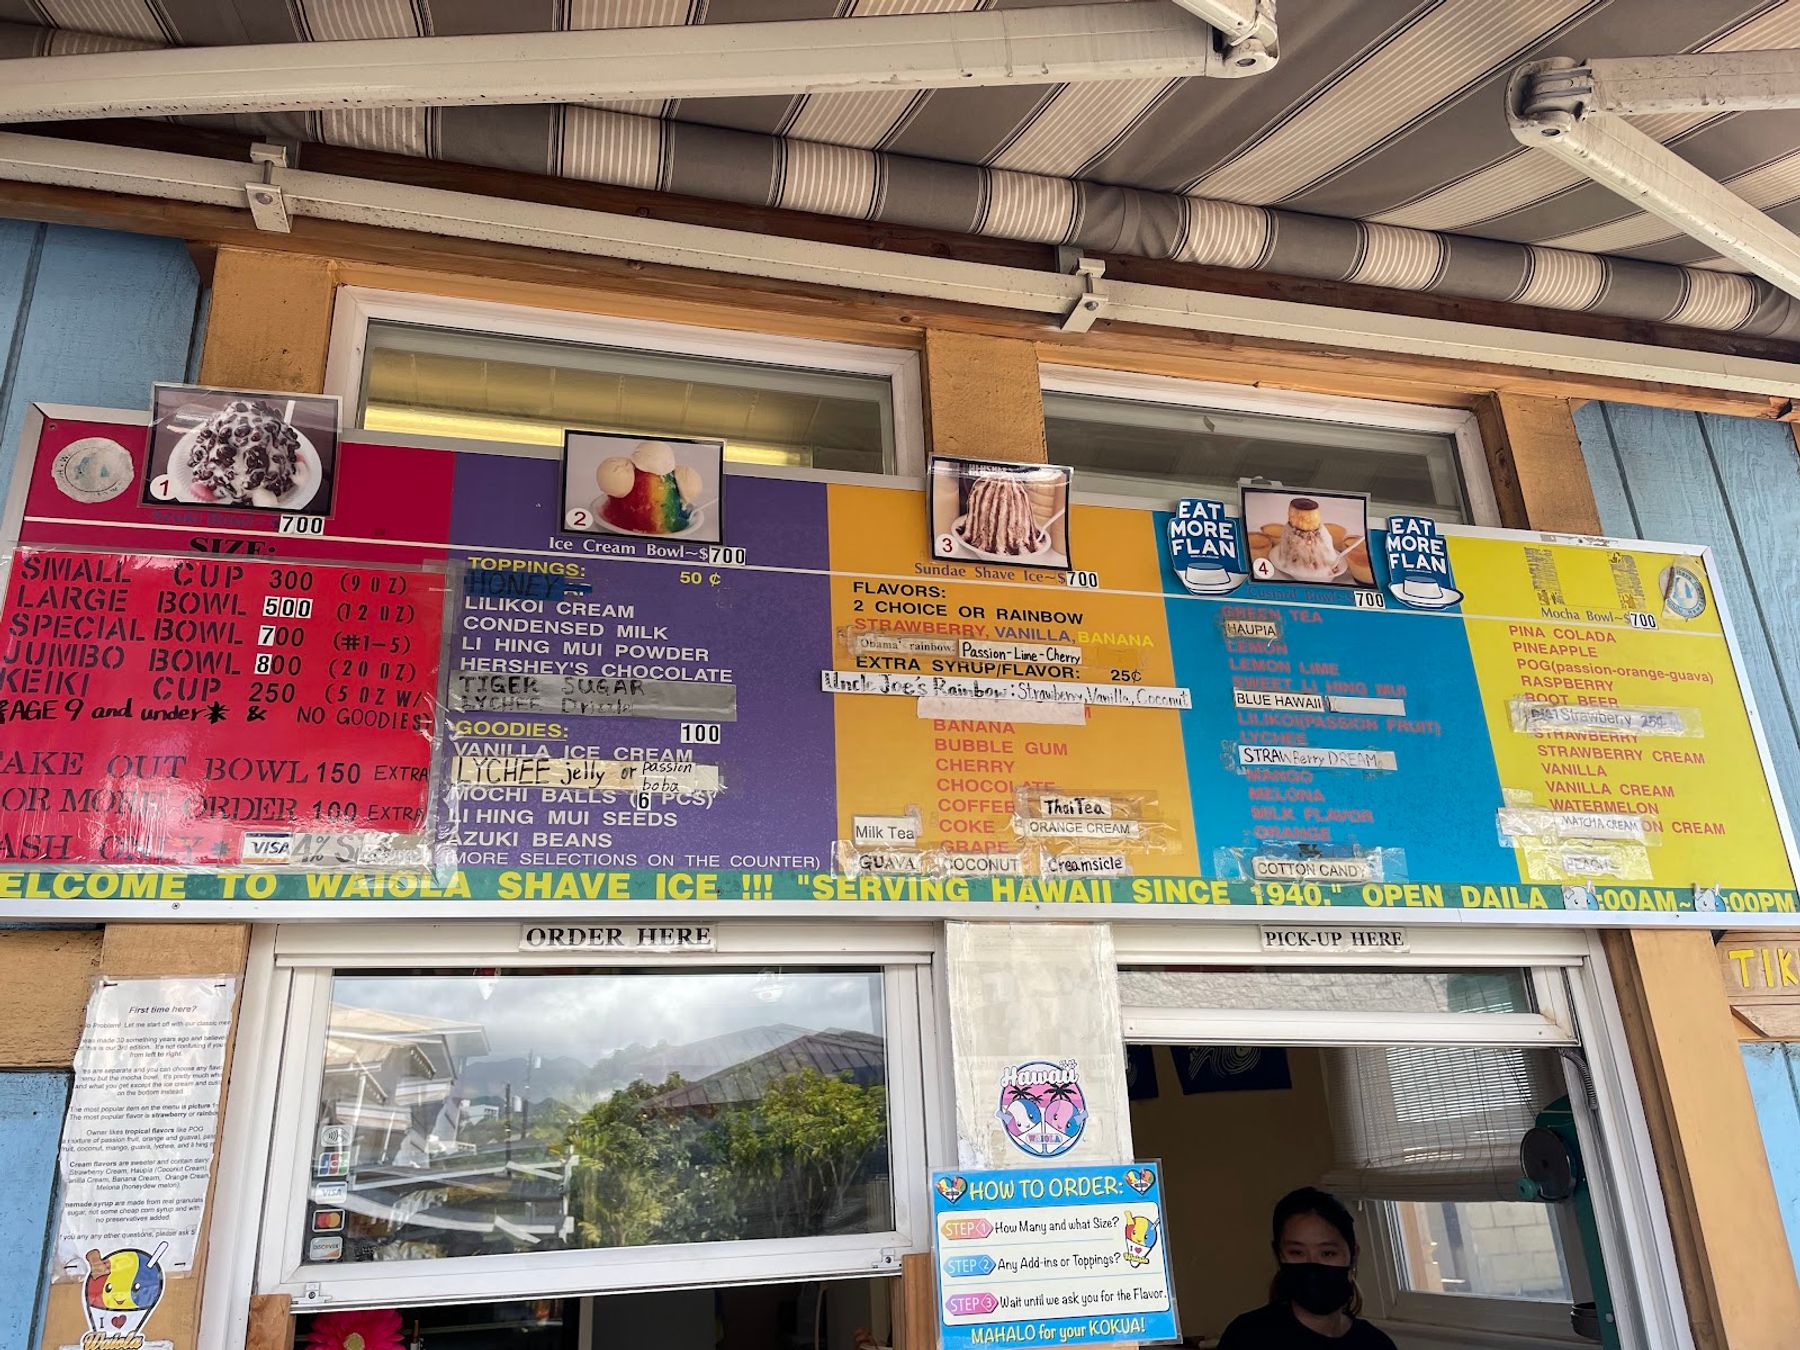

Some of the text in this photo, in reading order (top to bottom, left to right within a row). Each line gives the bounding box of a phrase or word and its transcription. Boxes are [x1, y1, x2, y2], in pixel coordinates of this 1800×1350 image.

[159, 480, 170, 497] 1
[573, 511, 587, 527] 2
[1178, 501, 1222, 520] EAT
[280, 516, 324, 534] 700
[1171, 520, 1235, 540] MORE
[1390, 518, 1433, 538] EAT
[549, 537, 636, 555] Ice Cream
[941, 537, 953, 553] 3
[1172, 538, 1237, 559] FLAN
[1386, 536, 1444, 556] MORE
[21, 556, 313, 591] SMALL CUP 300
[468, 556, 586, 577] TOPPINGS:
[914, 562, 1016, 581] Sundae Shave
[1257, 561, 1269, 576] 4
[1388, 553, 1447, 575] FLAN
[853, 581, 946, 599] FLAVORS:
[17, 585, 312, 618] LARGE BOWL 500
[556, 601, 636, 619] CREAM
[853, 600, 1084, 626] 2 CHOICE RAINBOW
[1540, 606, 1581, 620] Mocha
[9, 613, 243, 645] SPECIAL BOWL
[463, 616, 669, 641] CONDENSED MILK
[1508, 624, 1618, 644] PINA COLADA
[1077, 631, 1155, 648] BANANA
[3, 641, 241, 674] JUMBO BOWL
[494, 639, 710, 662] HING MUI POWDER
[1513, 641, 1599, 659] PINEAPPLE
[460, 657, 733, 683] HERSHEY'S CHOCOLATE
[856, 655, 920, 672] EXTRA
[1229, 657, 1340, 677] LEMON LIME
[153, 677, 295, 703] CUP 250
[459, 675, 646, 696] TIGER SUGAR
[1520, 674, 1614, 692] RASPBERRY
[1236, 692, 1322, 709] BLUE HAWAII
[456, 720, 569, 739] GOODIES:
[933, 719, 1016, 735] BANANA
[453, 742, 694, 763] VANILLA ICE CREAM
[934, 738, 1069, 757] BUBBLE GUM
[1536, 743, 1706, 764] STRAWBERRY CREAM
[107, 755, 361, 784] OUT BOWL 150
[457, 756, 607, 788] LYCHEE jelly
[935, 757, 1016, 774] CHERRY
[1540, 762, 1608, 778] VANILLA
[454, 787, 617, 805] MOCHI BALLS
[1248, 786, 1326, 803] MELONA
[1545, 779, 1676, 799] VANILLA CREAM
[313, 800, 357, 822] 100
[938, 797, 1016, 814] COFFEE
[1548, 798, 1660, 816] WATERMELON
[476, 809, 678, 828] HING MUI SEEDS
[1304, 808, 1374, 824] FLAVOR
[939, 818, 996, 835] COKE
[1029, 820, 1131, 835] ORANGE CREAM
[1253, 825, 1332, 841] ORANGE
[1671, 820, 1726, 836] CREAM
[251, 841, 290, 855] VISA
[449, 831, 613, 848] AZUKI BEANS
[519, 852, 821, 871] SELECTIONS THE COUNTER)
[217, 872, 1549, 909] TO WAIOLA SHAVE ICE HAWAII SINCE OPEN DAILA
[526, 926, 713, 948] ORDER HERE
[1264, 930, 1405, 948] PICK-UP HERE
[128, 1004, 199, 1015] First time here?
[151, 1111, 187, 1119] strawberry
[125, 1128, 151, 1136] tropical
[968, 1175, 1125, 1202] HOW TO ORDER:
[944, 1215, 1120, 1238] STEP How Many what Size?
[947, 1252, 1122, 1275] STEP Add-ins Toppings?
[949, 1297, 981, 1313] STEP
[998, 1295, 1023, 1310] Wait
[970, 1316, 1147, 1345] MAHALO your KOKUA!
